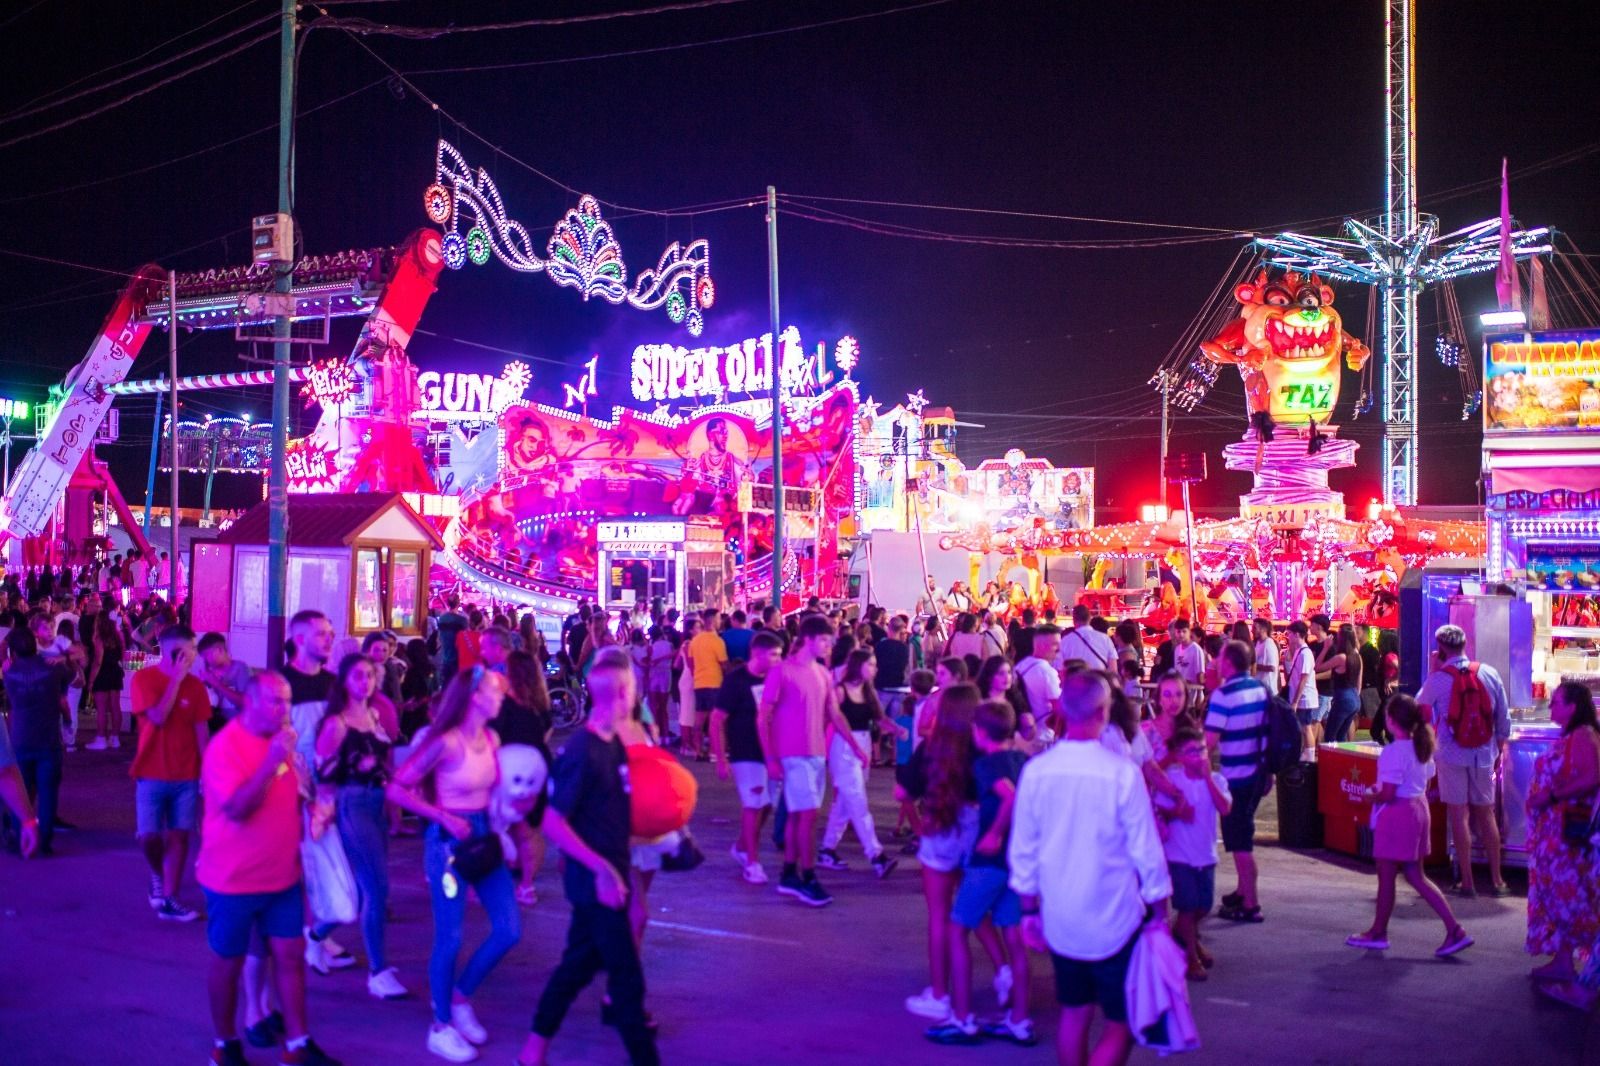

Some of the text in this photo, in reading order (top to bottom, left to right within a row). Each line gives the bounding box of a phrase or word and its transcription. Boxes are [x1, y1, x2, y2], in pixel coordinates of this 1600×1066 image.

[1491, 341, 1579, 364] PATATAS
[631, 343, 725, 402] SUPER
[1554, 365, 1600, 377] PATA
[1281, 383, 1333, 409] TAZ
[50, 413, 86, 466] TOP
[1340, 778, 1366, 795] Estrell
